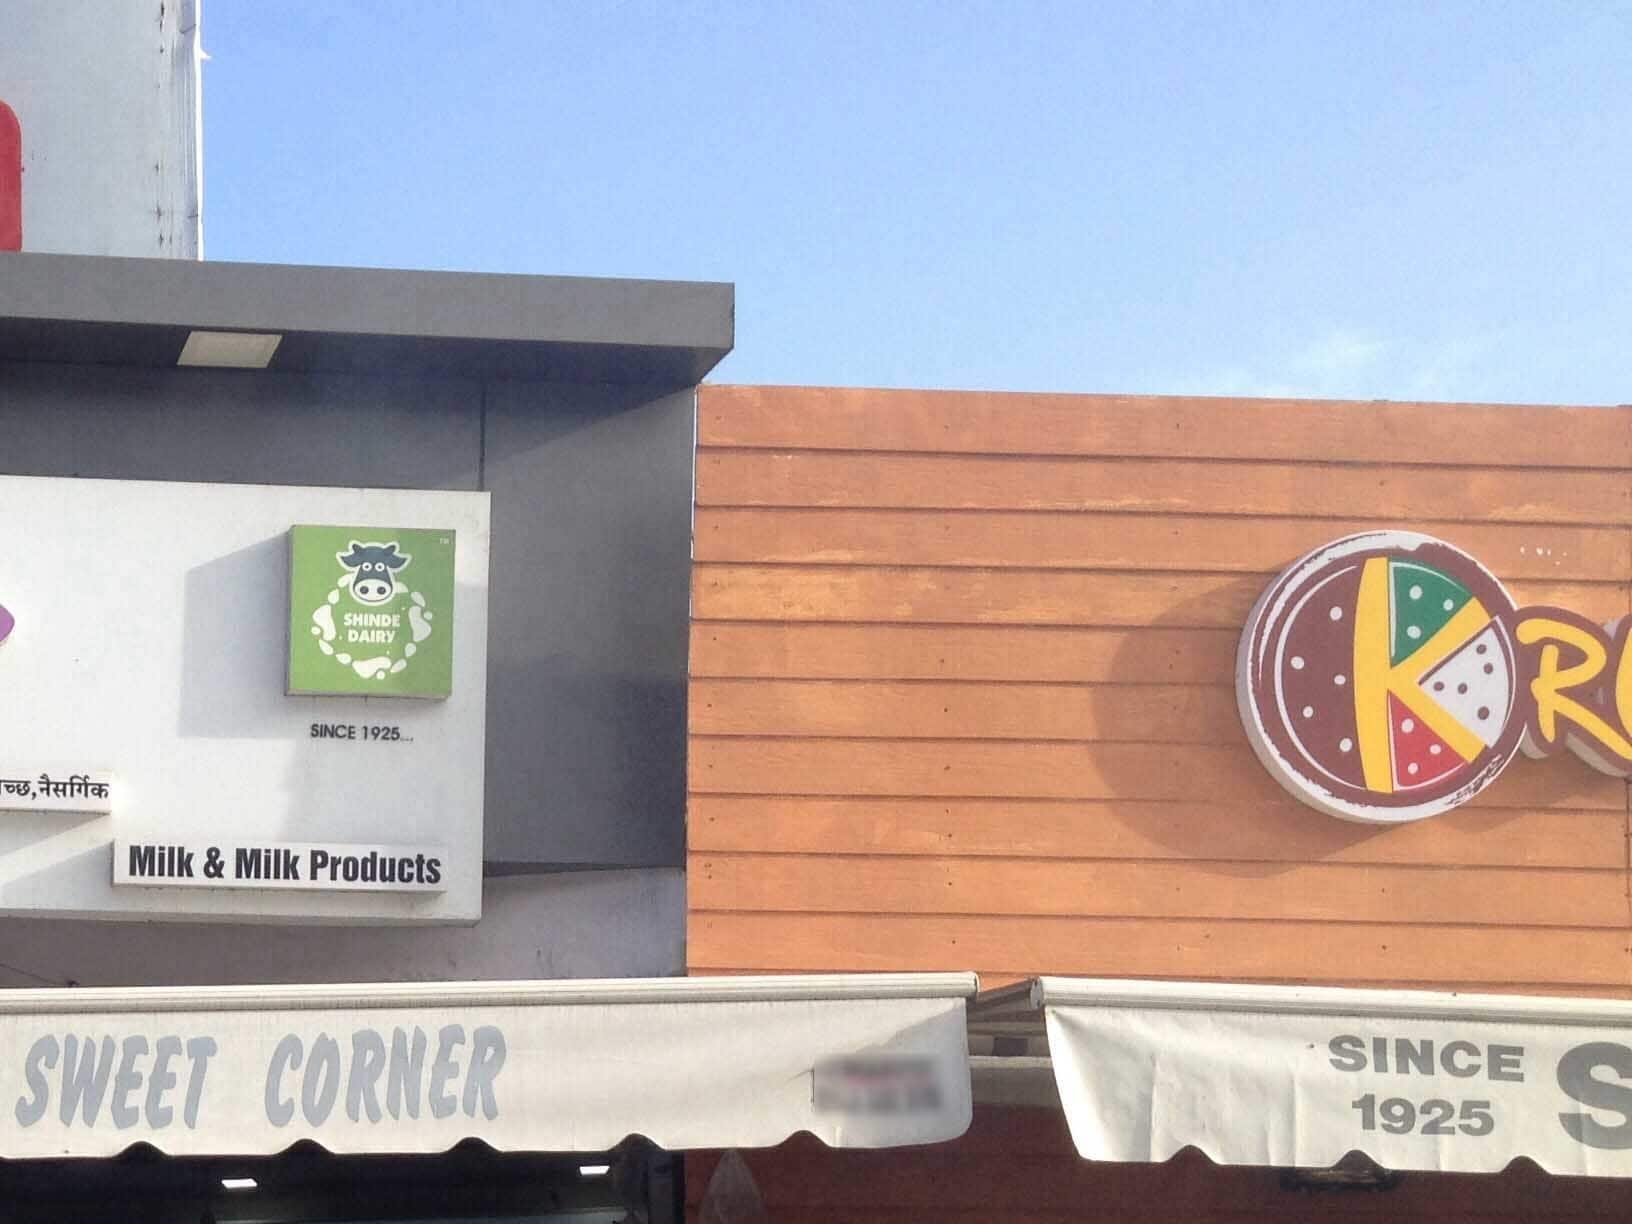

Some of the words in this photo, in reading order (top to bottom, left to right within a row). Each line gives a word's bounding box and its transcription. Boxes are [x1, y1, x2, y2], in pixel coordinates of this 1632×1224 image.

[343, 613, 400, 627] SHINDE
[348, 629, 395, 643] DAIRY
[311, 724, 356, 739] SINCE
[129, 845, 194, 878] Milk
[203, 847, 224, 879] &
[235, 847, 300, 880] Milk
[309, 849, 442, 885] Products
[15, 1031, 218, 1130] SWEET
[264, 1023, 507, 1129] CORNER
[1329, 1034, 1525, 1083] SINCE
[1351, 1093, 1495, 1138] 1925
